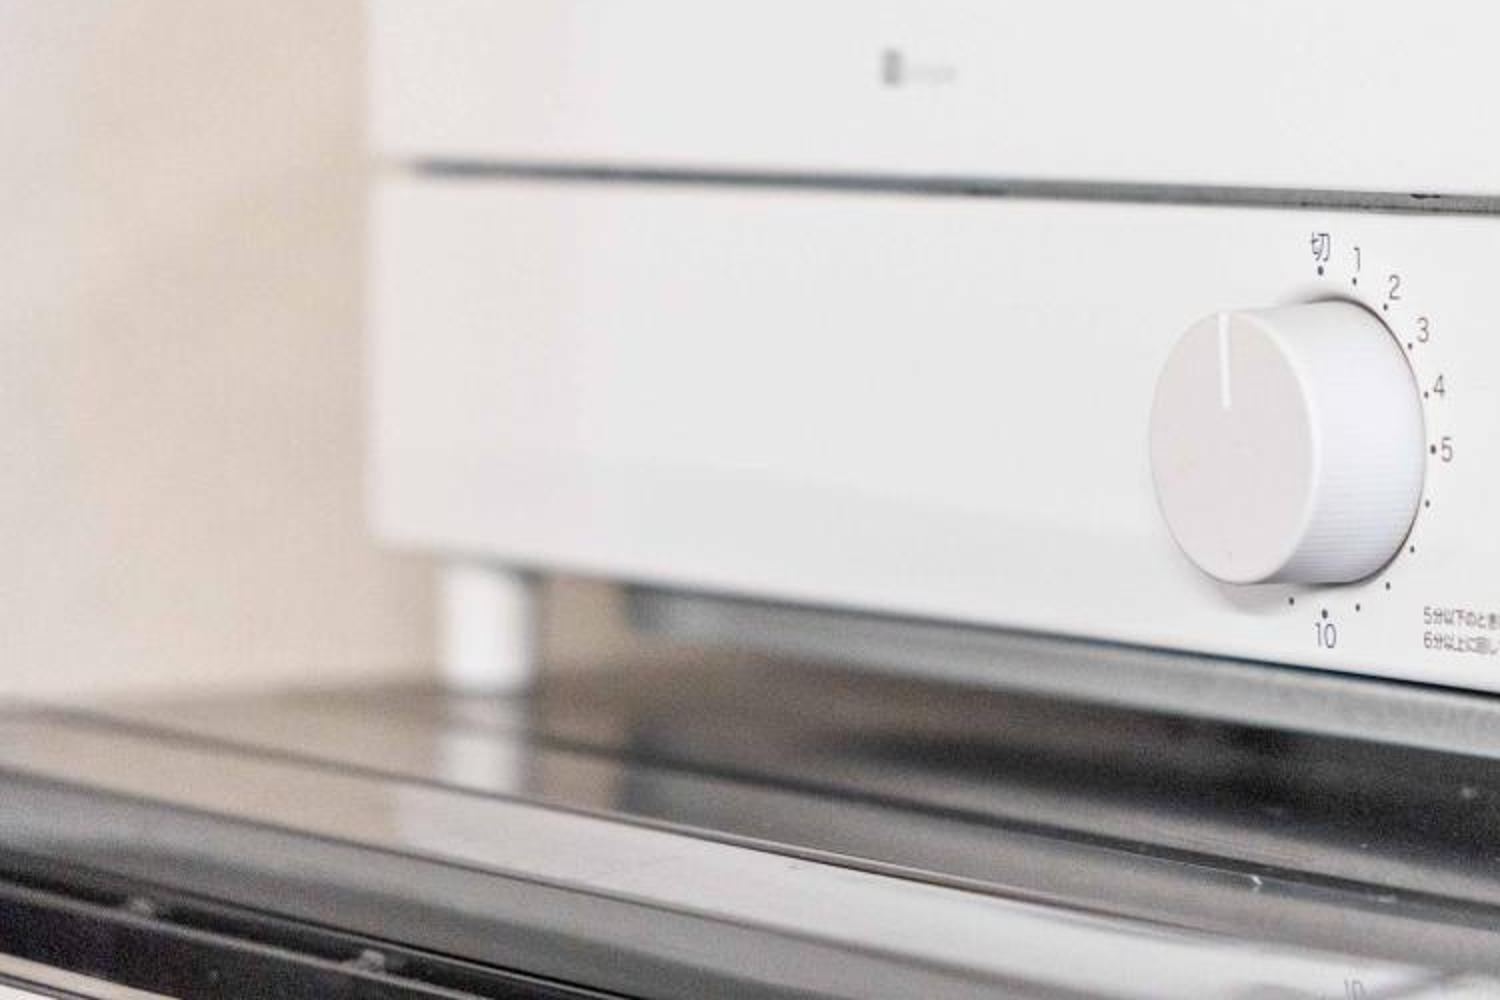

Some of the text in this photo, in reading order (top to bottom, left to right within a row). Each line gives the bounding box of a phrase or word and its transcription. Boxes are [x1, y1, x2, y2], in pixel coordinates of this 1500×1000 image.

[1310, 232, 1331, 262] 切
[1352, 246, 1361, 272] 1
[1387, 273, 1402, 301] 2
[1415, 316, 1431, 343] 3
[1432, 374, 1446, 397] 4
[1440, 436, 1454, 463] 5
[1314, 621, 1337, 649] 10
